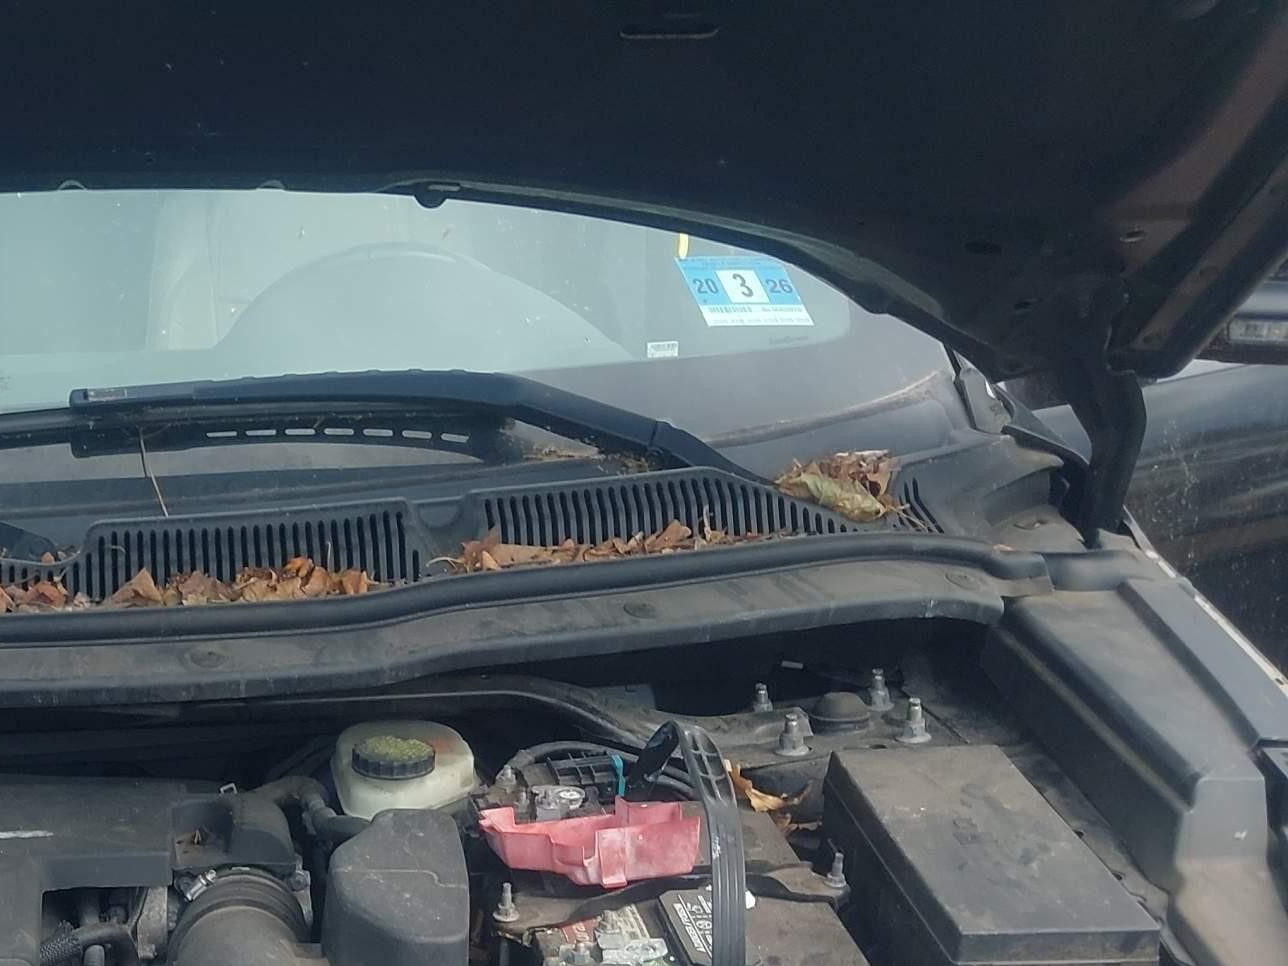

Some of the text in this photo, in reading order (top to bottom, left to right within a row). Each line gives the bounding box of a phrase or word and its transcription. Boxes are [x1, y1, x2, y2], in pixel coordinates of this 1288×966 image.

[692, 273, 794, 298] 20 3 26
